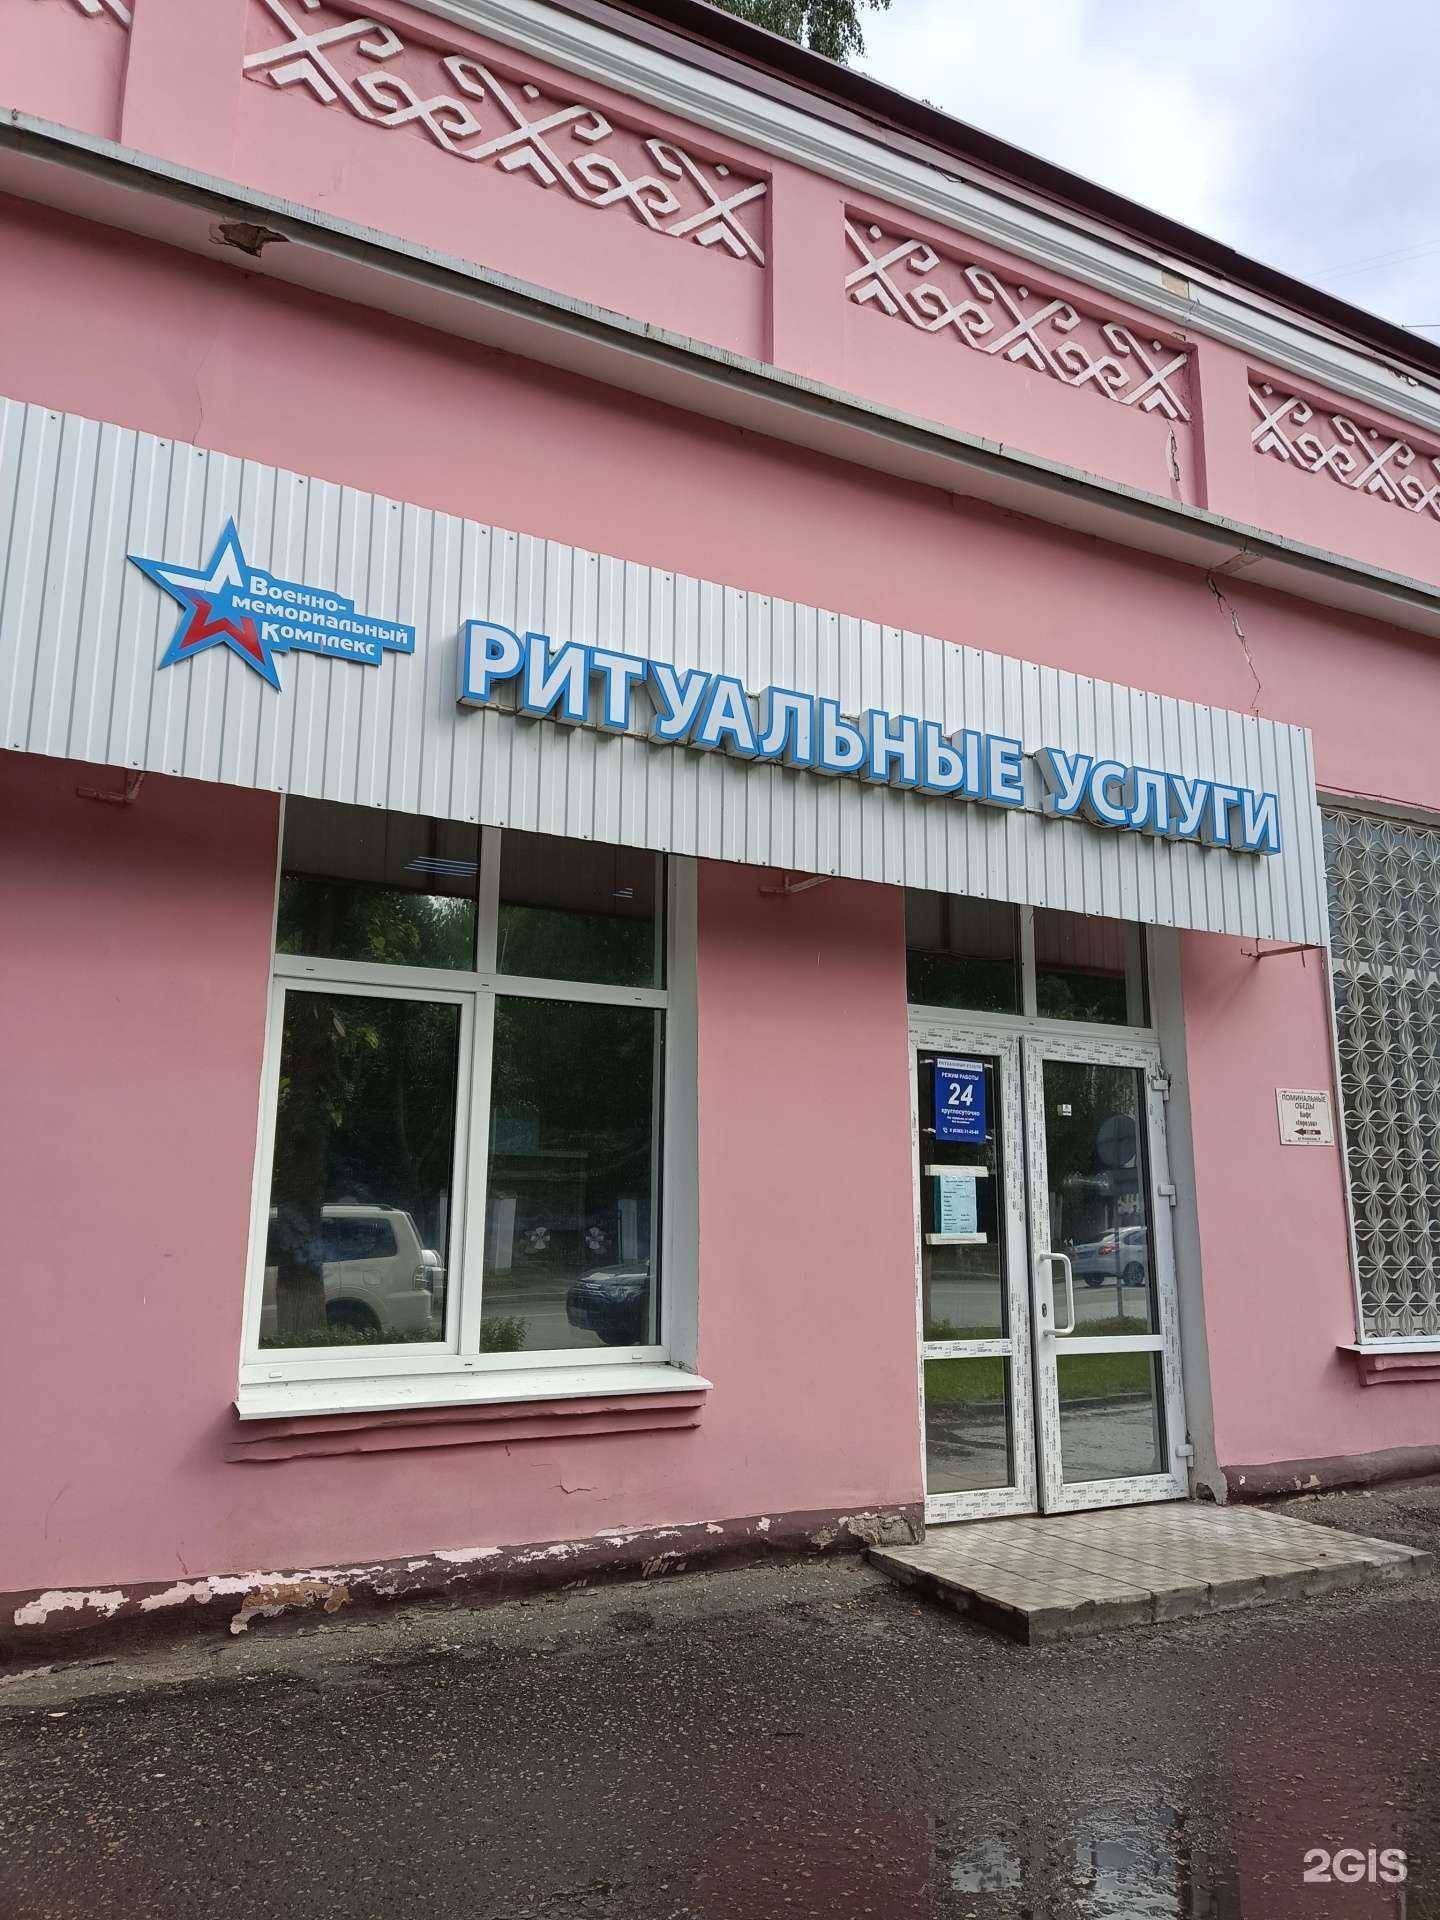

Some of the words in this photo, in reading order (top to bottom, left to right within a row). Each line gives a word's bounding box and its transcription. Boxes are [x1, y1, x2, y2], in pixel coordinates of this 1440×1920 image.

[249, 574, 347, 612] Военно-
[231, 594, 408, 645] мемориальный
[261, 620, 376, 657] Комплекс
[463, 619, 1024, 807] РИТУАЛЬНЫЕ
[1045, 746, 1281, 855] УСЛУГИ
[948, 1082, 974, 1106] 24
[1294, 1102, 1315, 1110] ОБЕДЫ
